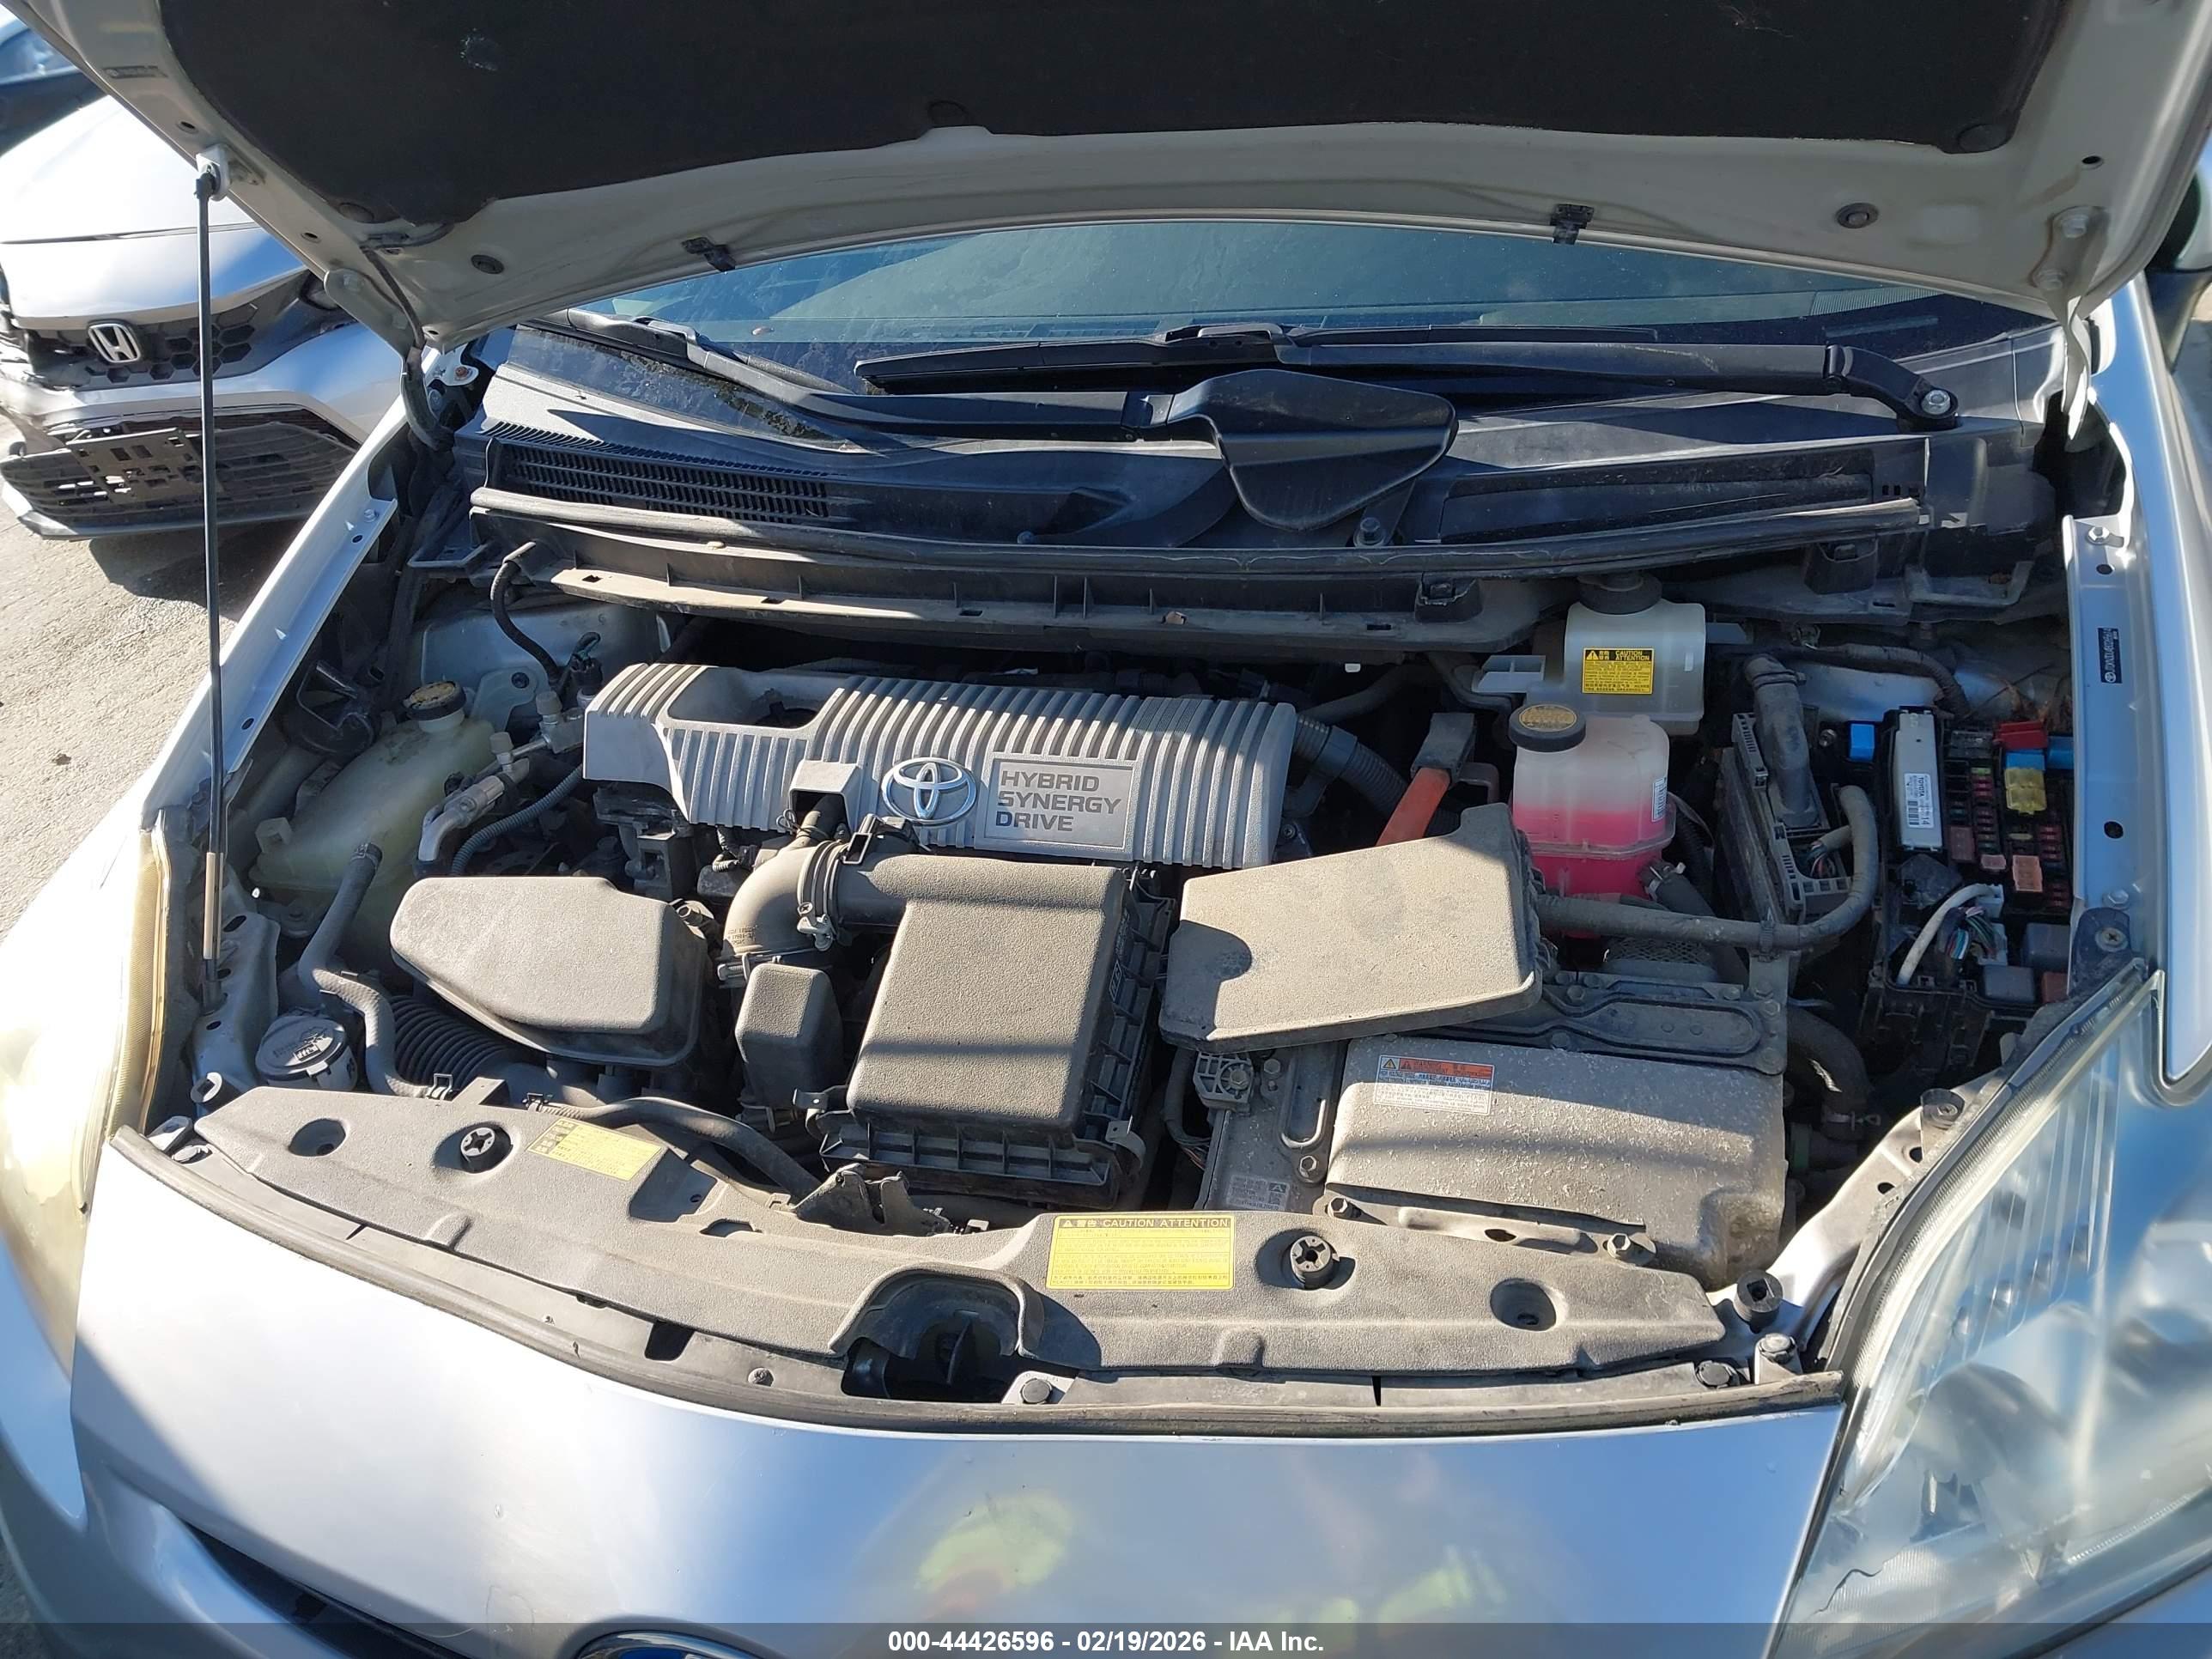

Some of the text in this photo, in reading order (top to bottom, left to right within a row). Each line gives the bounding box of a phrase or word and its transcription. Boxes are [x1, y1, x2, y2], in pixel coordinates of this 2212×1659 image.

[1000, 770, 1099, 792] HYBRID
[998, 791, 1121, 814] SYNERGY
[995, 811, 1073, 831] DRIVE
[1103, 1218, 1229, 1228] CAUTION ATTENTION
